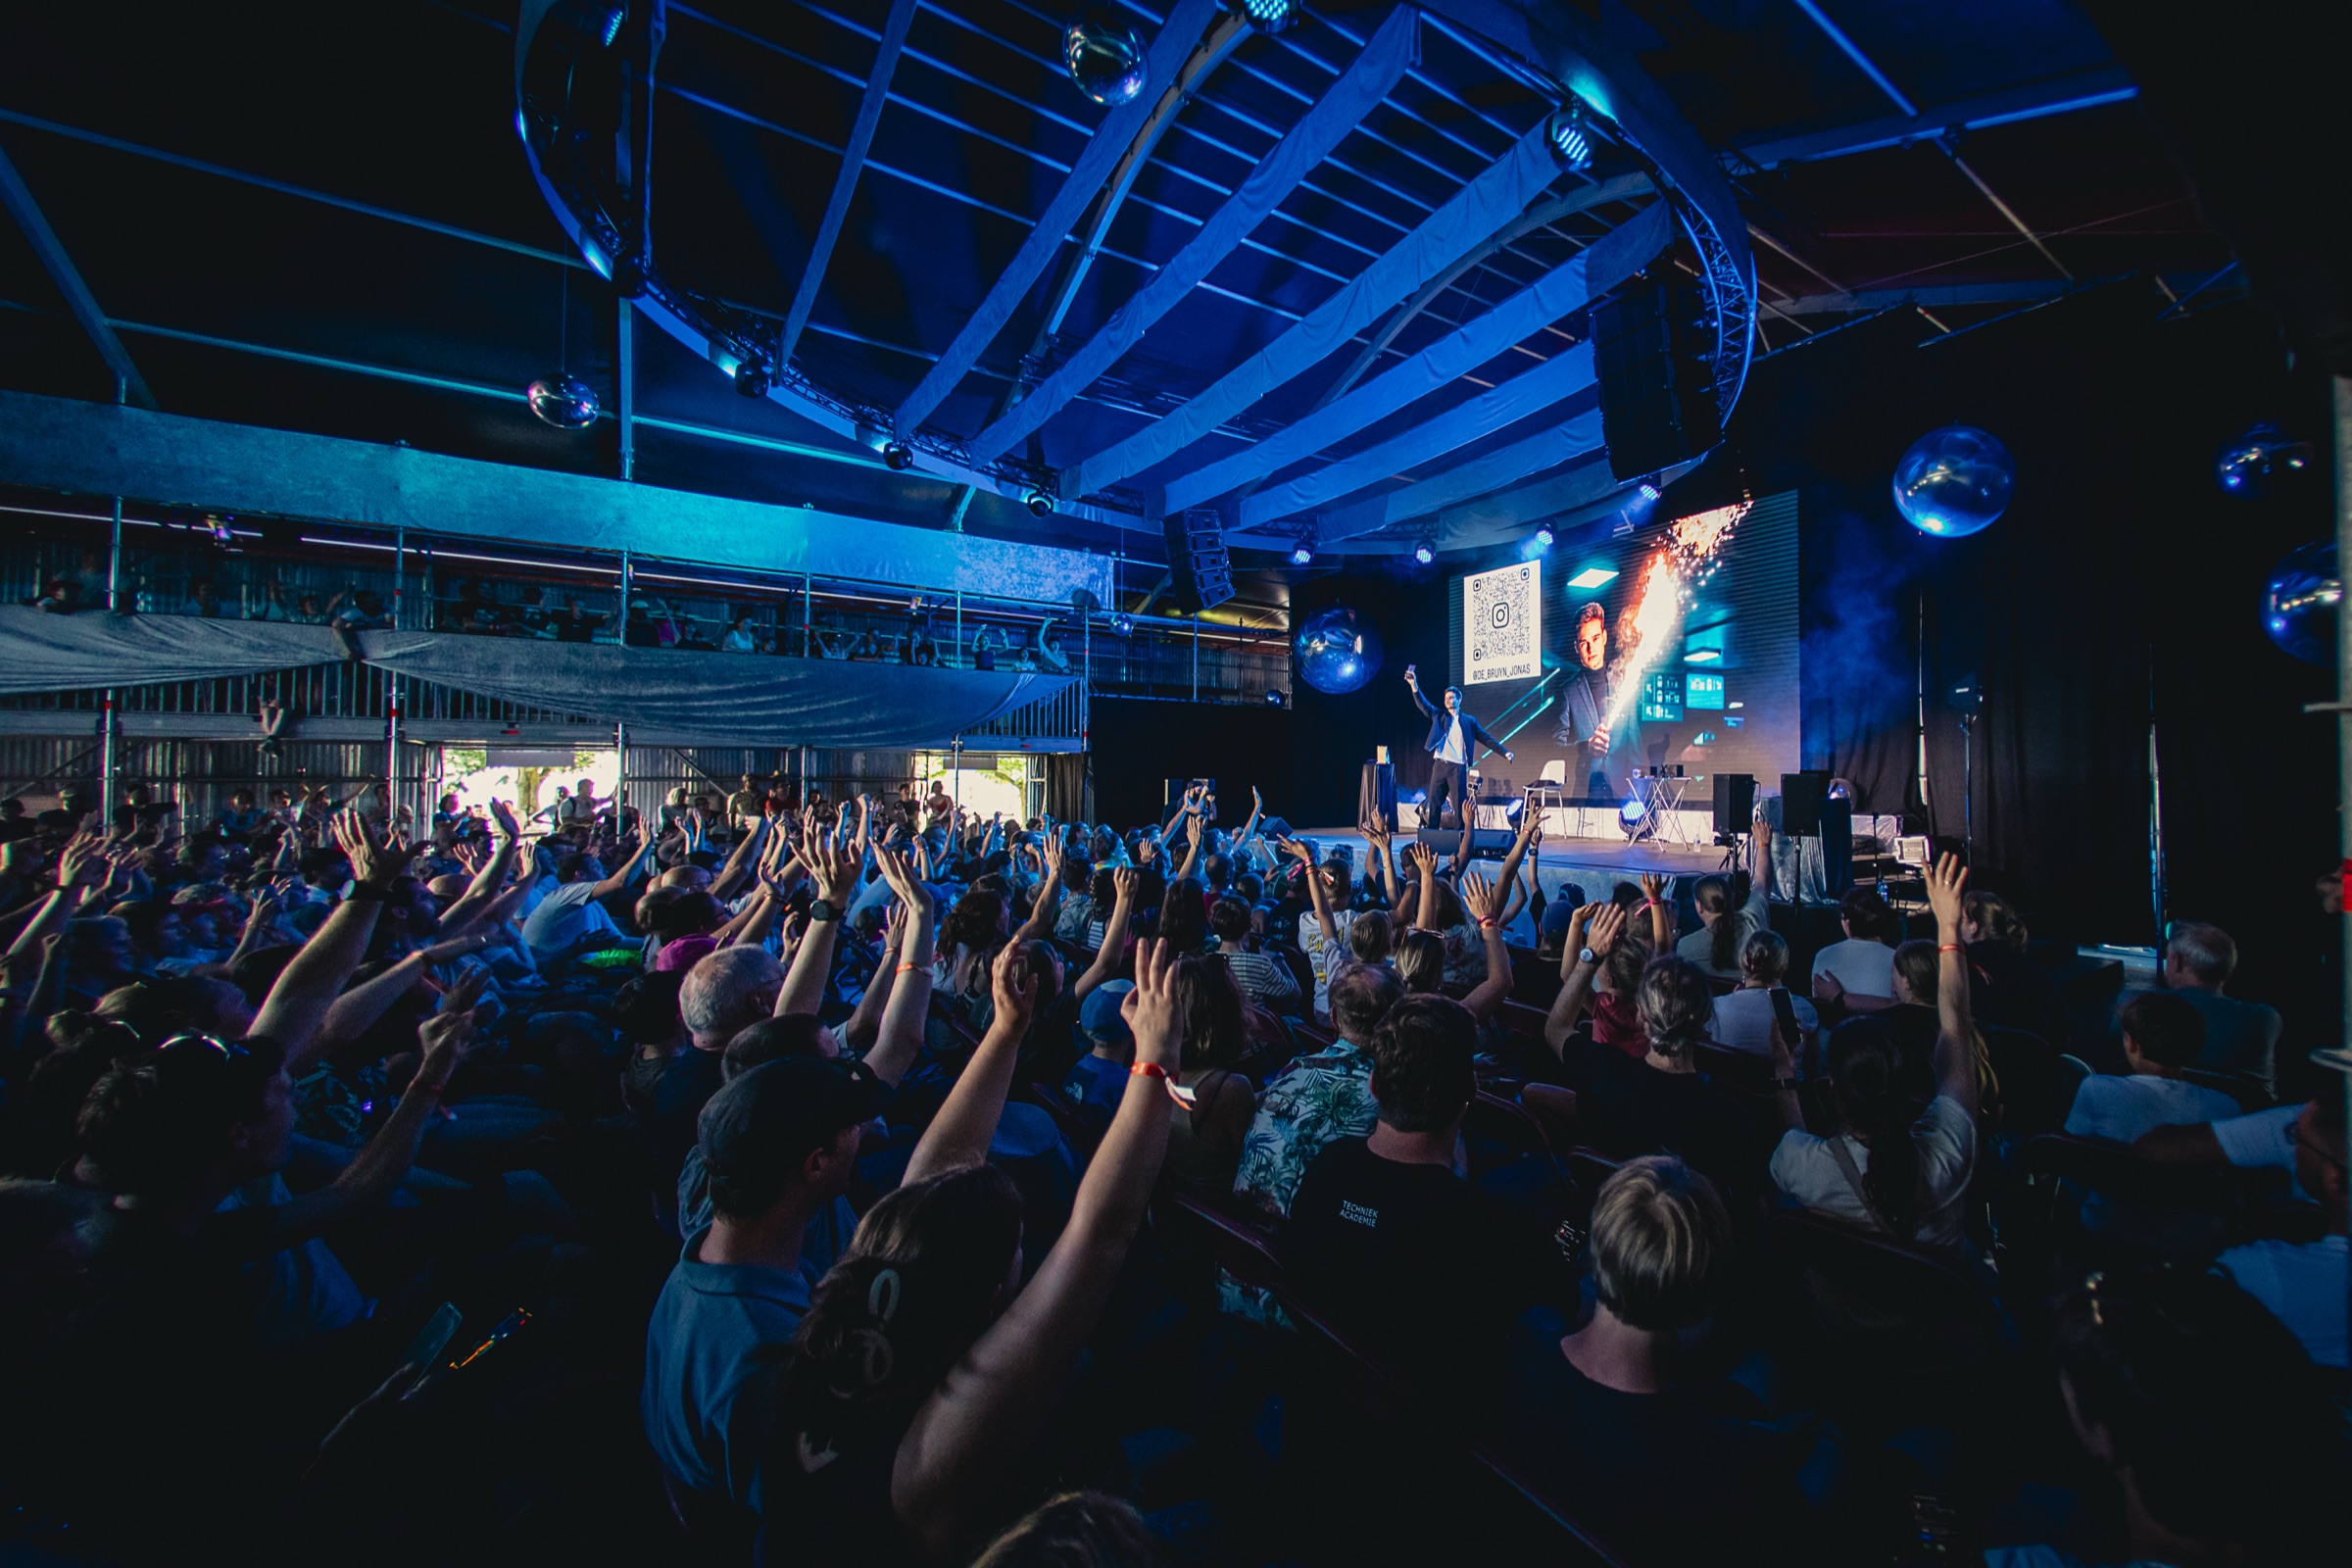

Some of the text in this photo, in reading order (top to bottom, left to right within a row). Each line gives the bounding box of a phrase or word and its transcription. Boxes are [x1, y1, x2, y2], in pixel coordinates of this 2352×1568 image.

[1473, 663, 1531, 680] @DE_BRUYN_JONAS
[1340, 1209, 1377, 1227] ACADEMIE
[1343, 1200, 1379, 1219] TECHNIEK
